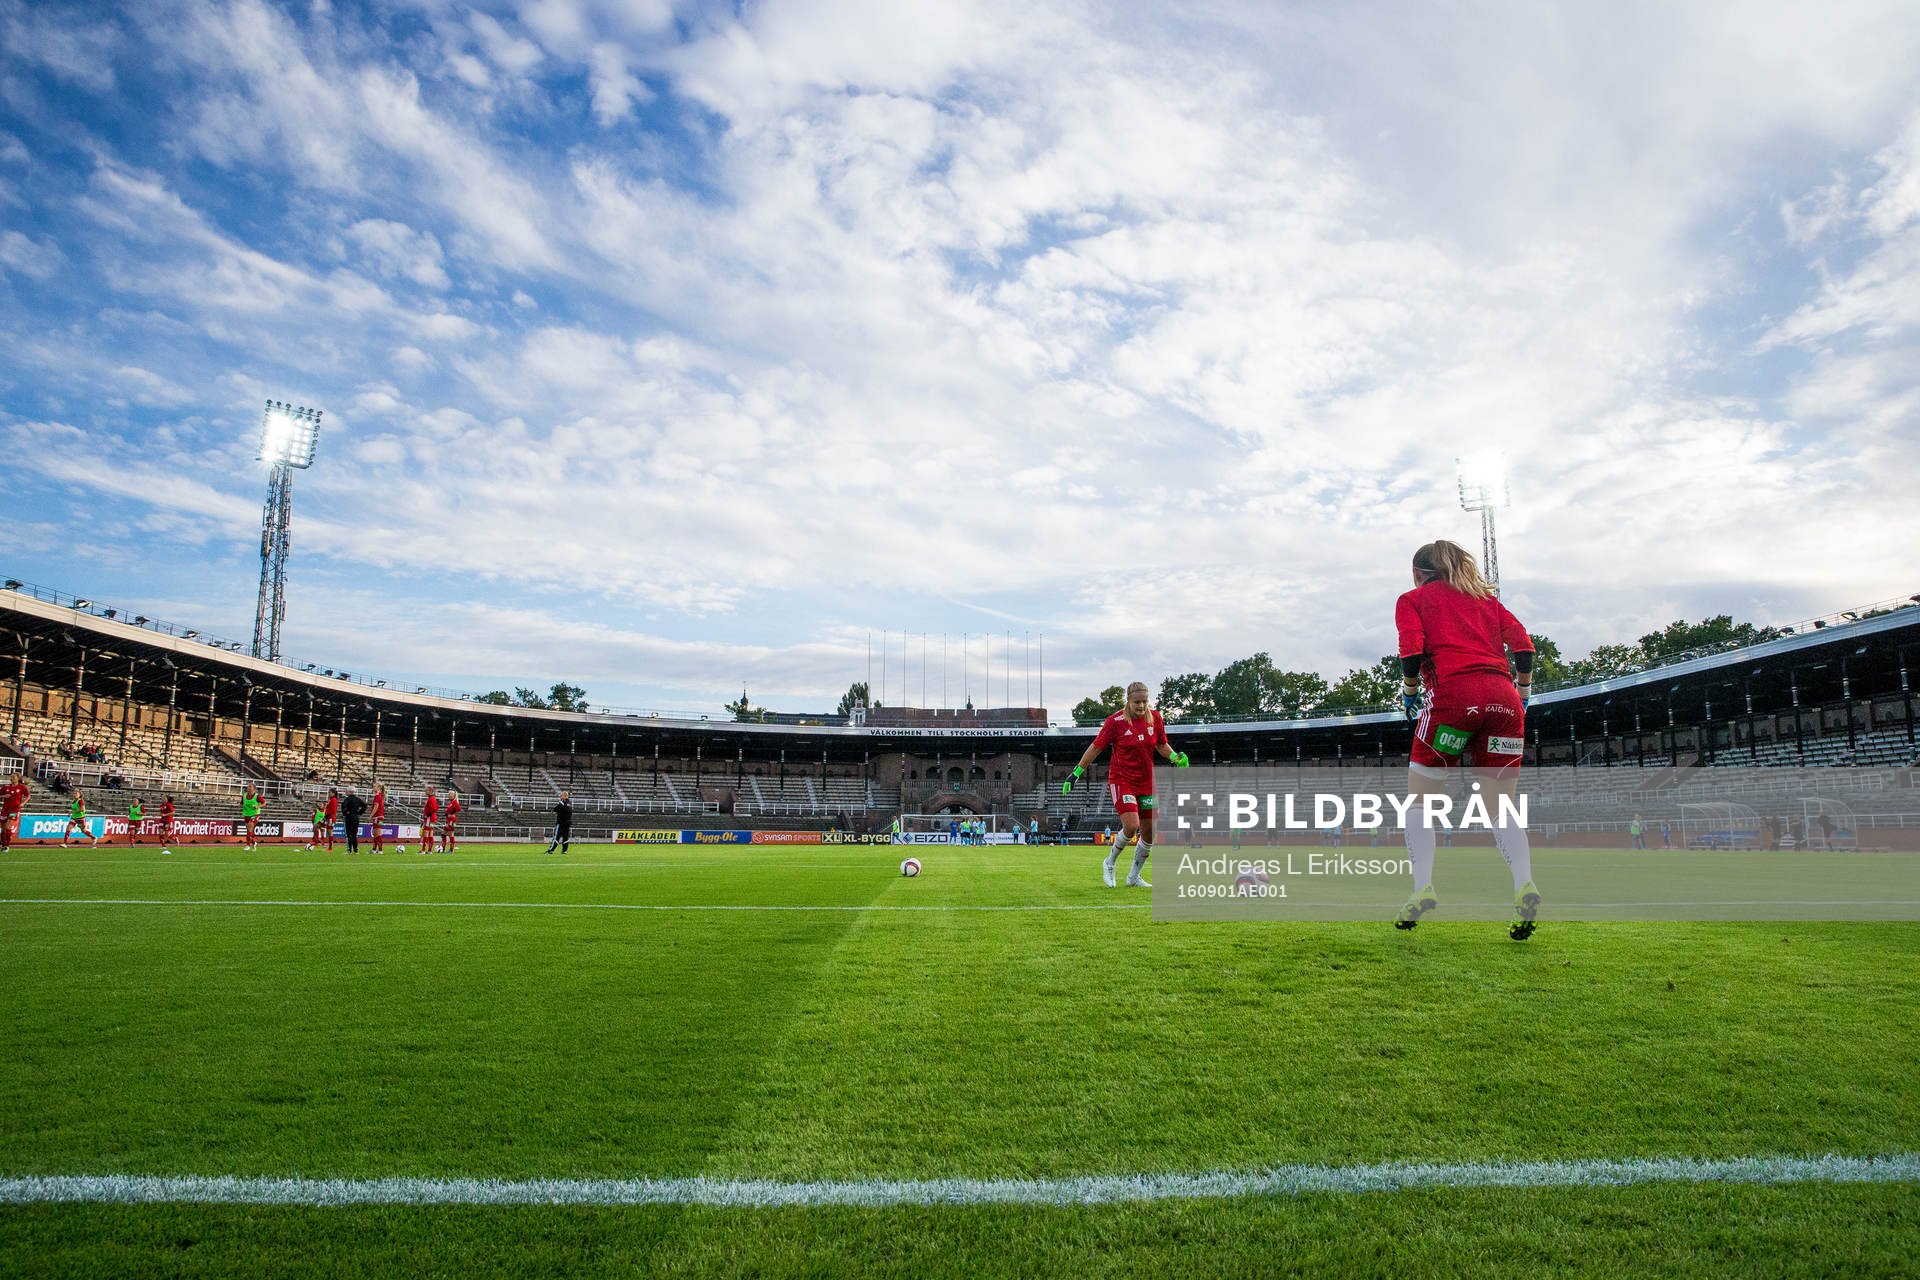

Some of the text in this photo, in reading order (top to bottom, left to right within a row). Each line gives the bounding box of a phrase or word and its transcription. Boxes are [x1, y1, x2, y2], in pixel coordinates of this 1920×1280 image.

[1485, 705, 1515, 717] KAIDING
[173, 820, 209, 836] Prioritet
[254, 823, 280, 837] adidas
[694, 831, 738, 842] Bygg-Ole
[843, 833, 891, 843] XL-BYGG
[914, 834, 948, 843] EIZO
